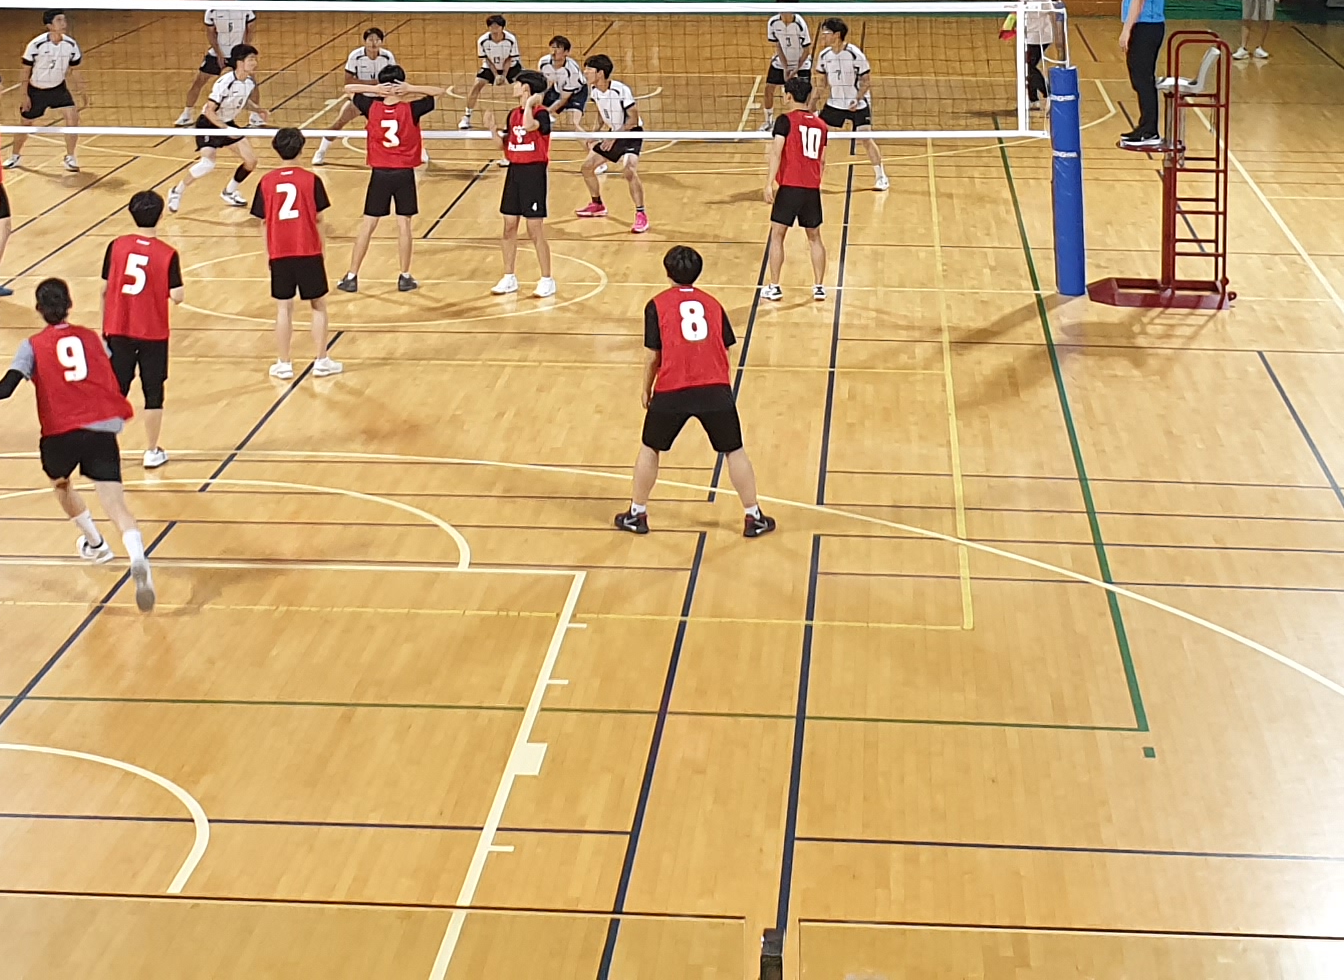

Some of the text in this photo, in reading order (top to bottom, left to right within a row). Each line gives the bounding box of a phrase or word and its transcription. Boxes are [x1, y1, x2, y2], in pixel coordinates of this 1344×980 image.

[380, 119, 400, 148] 3
[798, 125, 822, 159] 10
[276, 182, 299, 220] 2
[121, 252, 149, 295] 5
[679, 300, 709, 341] 8
[56, 335, 88, 382] 9
